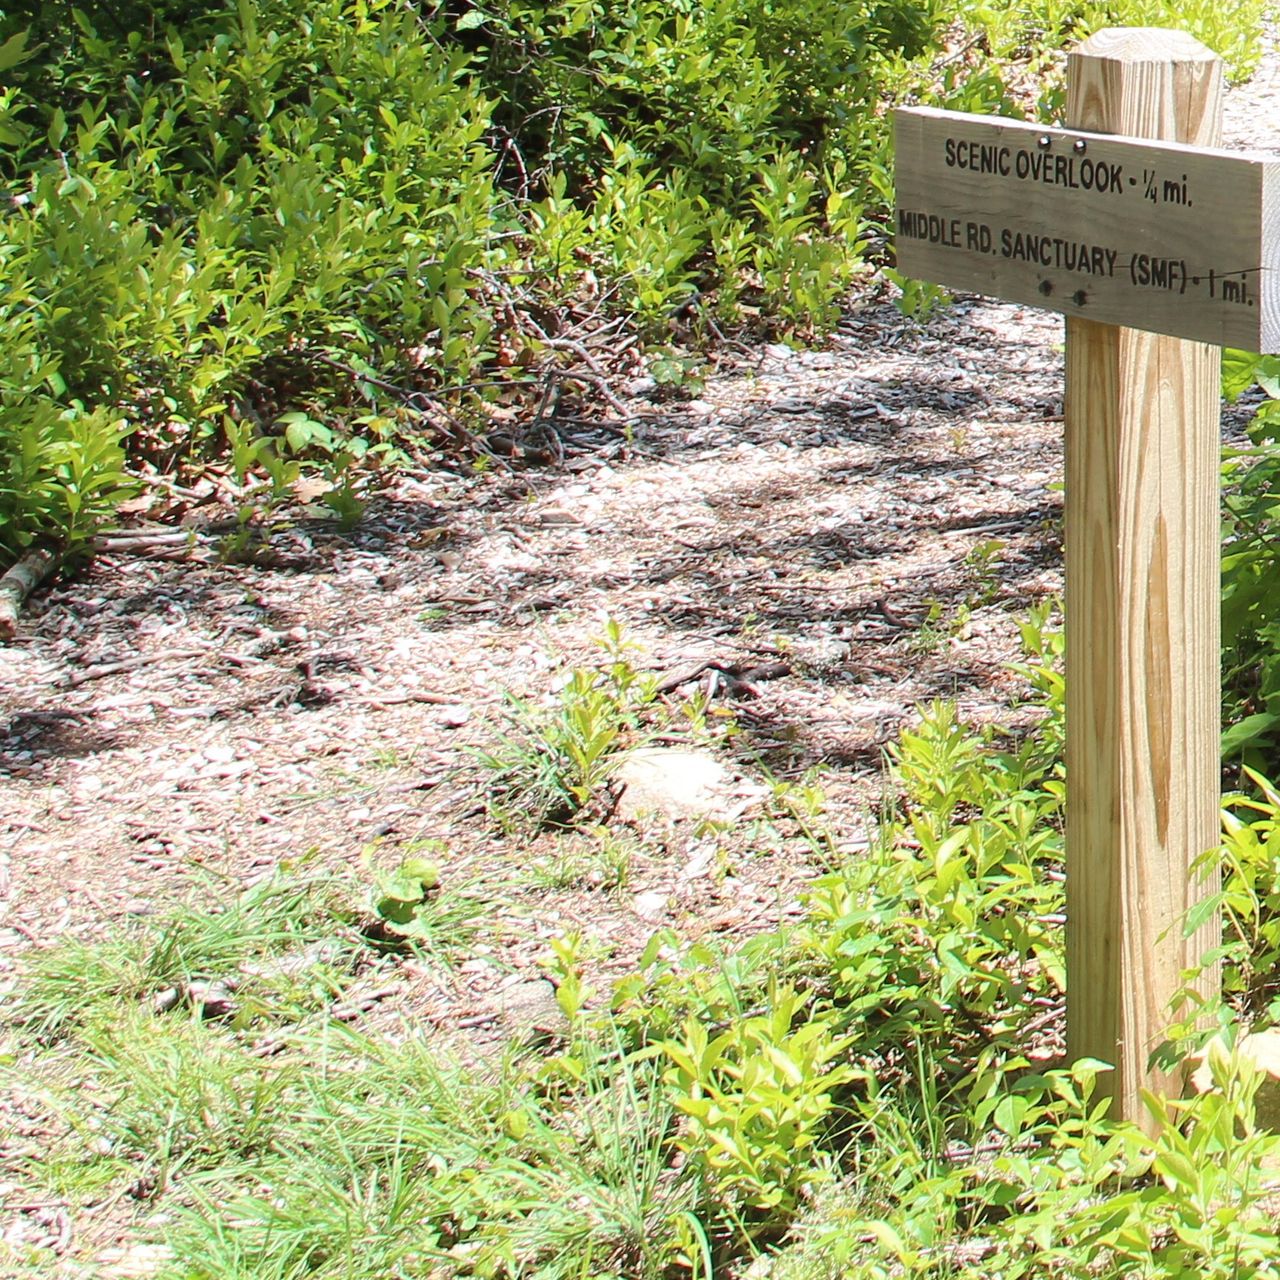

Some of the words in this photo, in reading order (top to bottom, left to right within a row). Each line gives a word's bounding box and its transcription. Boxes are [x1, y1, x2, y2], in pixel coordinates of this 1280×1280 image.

[945, 138, 1010, 177] SCENIC
[1015, 149, 1123, 195] OVERLOOK
[1163, 174, 1193, 207] mi.
[899, 209, 962, 248] MIDDLE
[966, 222, 997, 256] RD.
[1001, 228, 1118, 278] SANCTUARY
[1129, 253, 1187, 295] (SMF)
[1222, 273, 1254, 307] mi.
